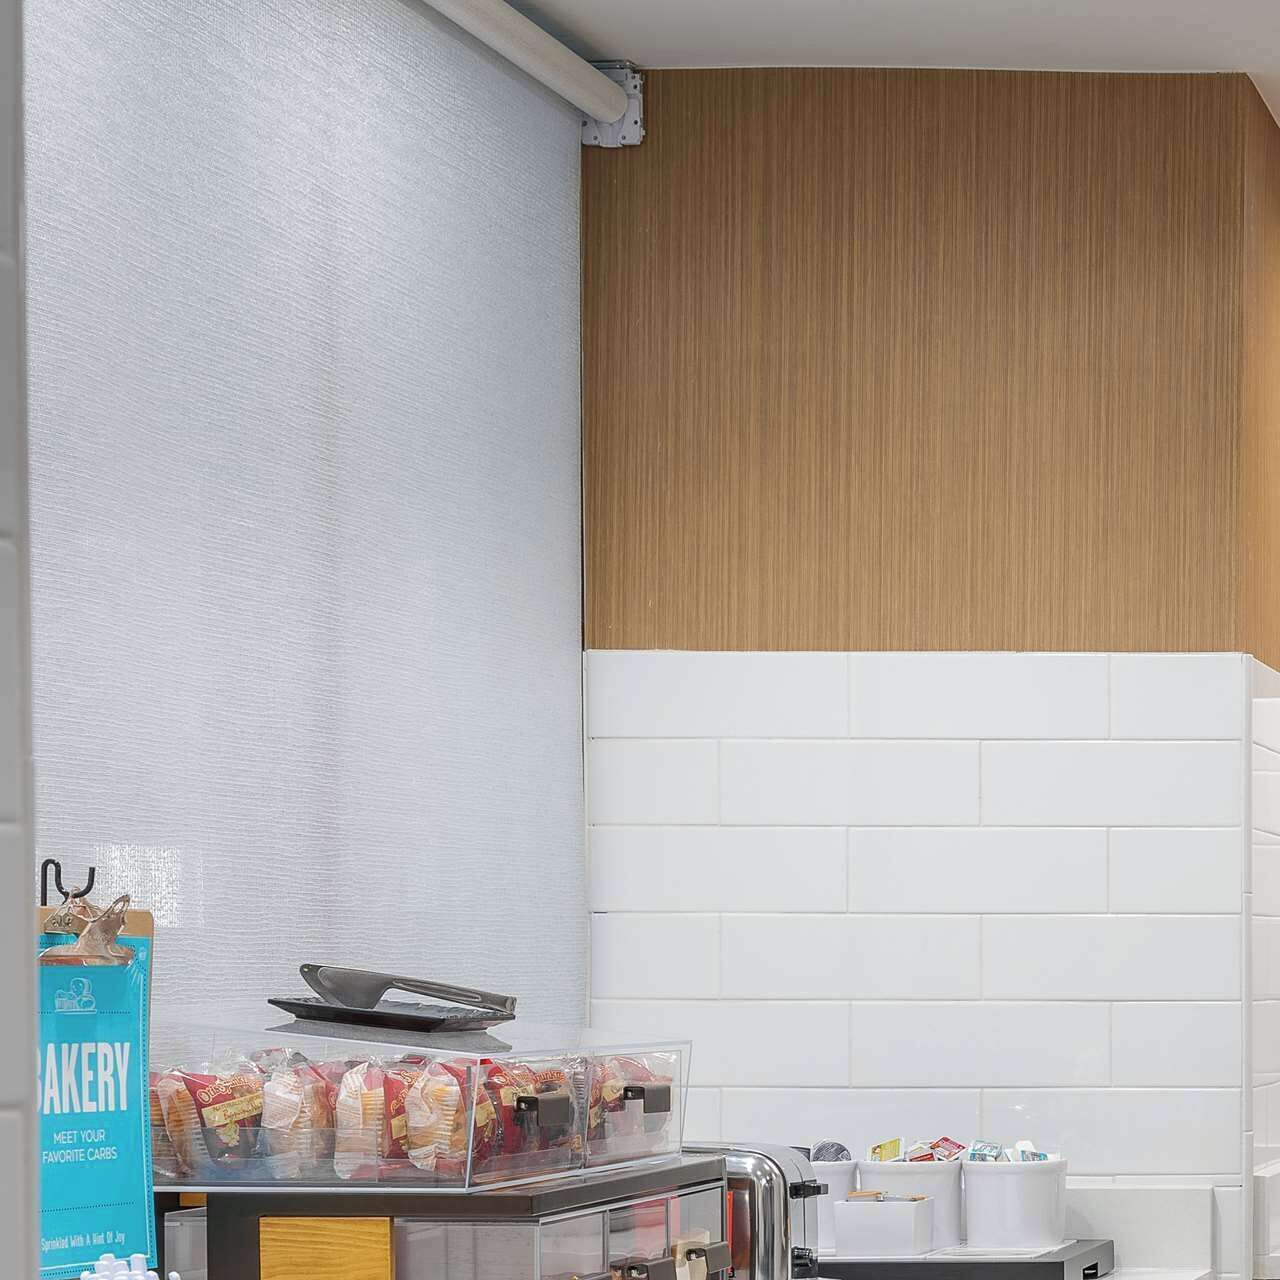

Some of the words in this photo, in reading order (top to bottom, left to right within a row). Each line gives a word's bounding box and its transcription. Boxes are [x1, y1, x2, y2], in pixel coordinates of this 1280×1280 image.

[53, 1130, 79, 1144] MEET
[80, 1129, 106, 1142] YOUR
[42, 1149, 86, 1164] FAVORITE
[87, 1146, 119, 1160] CARBS
